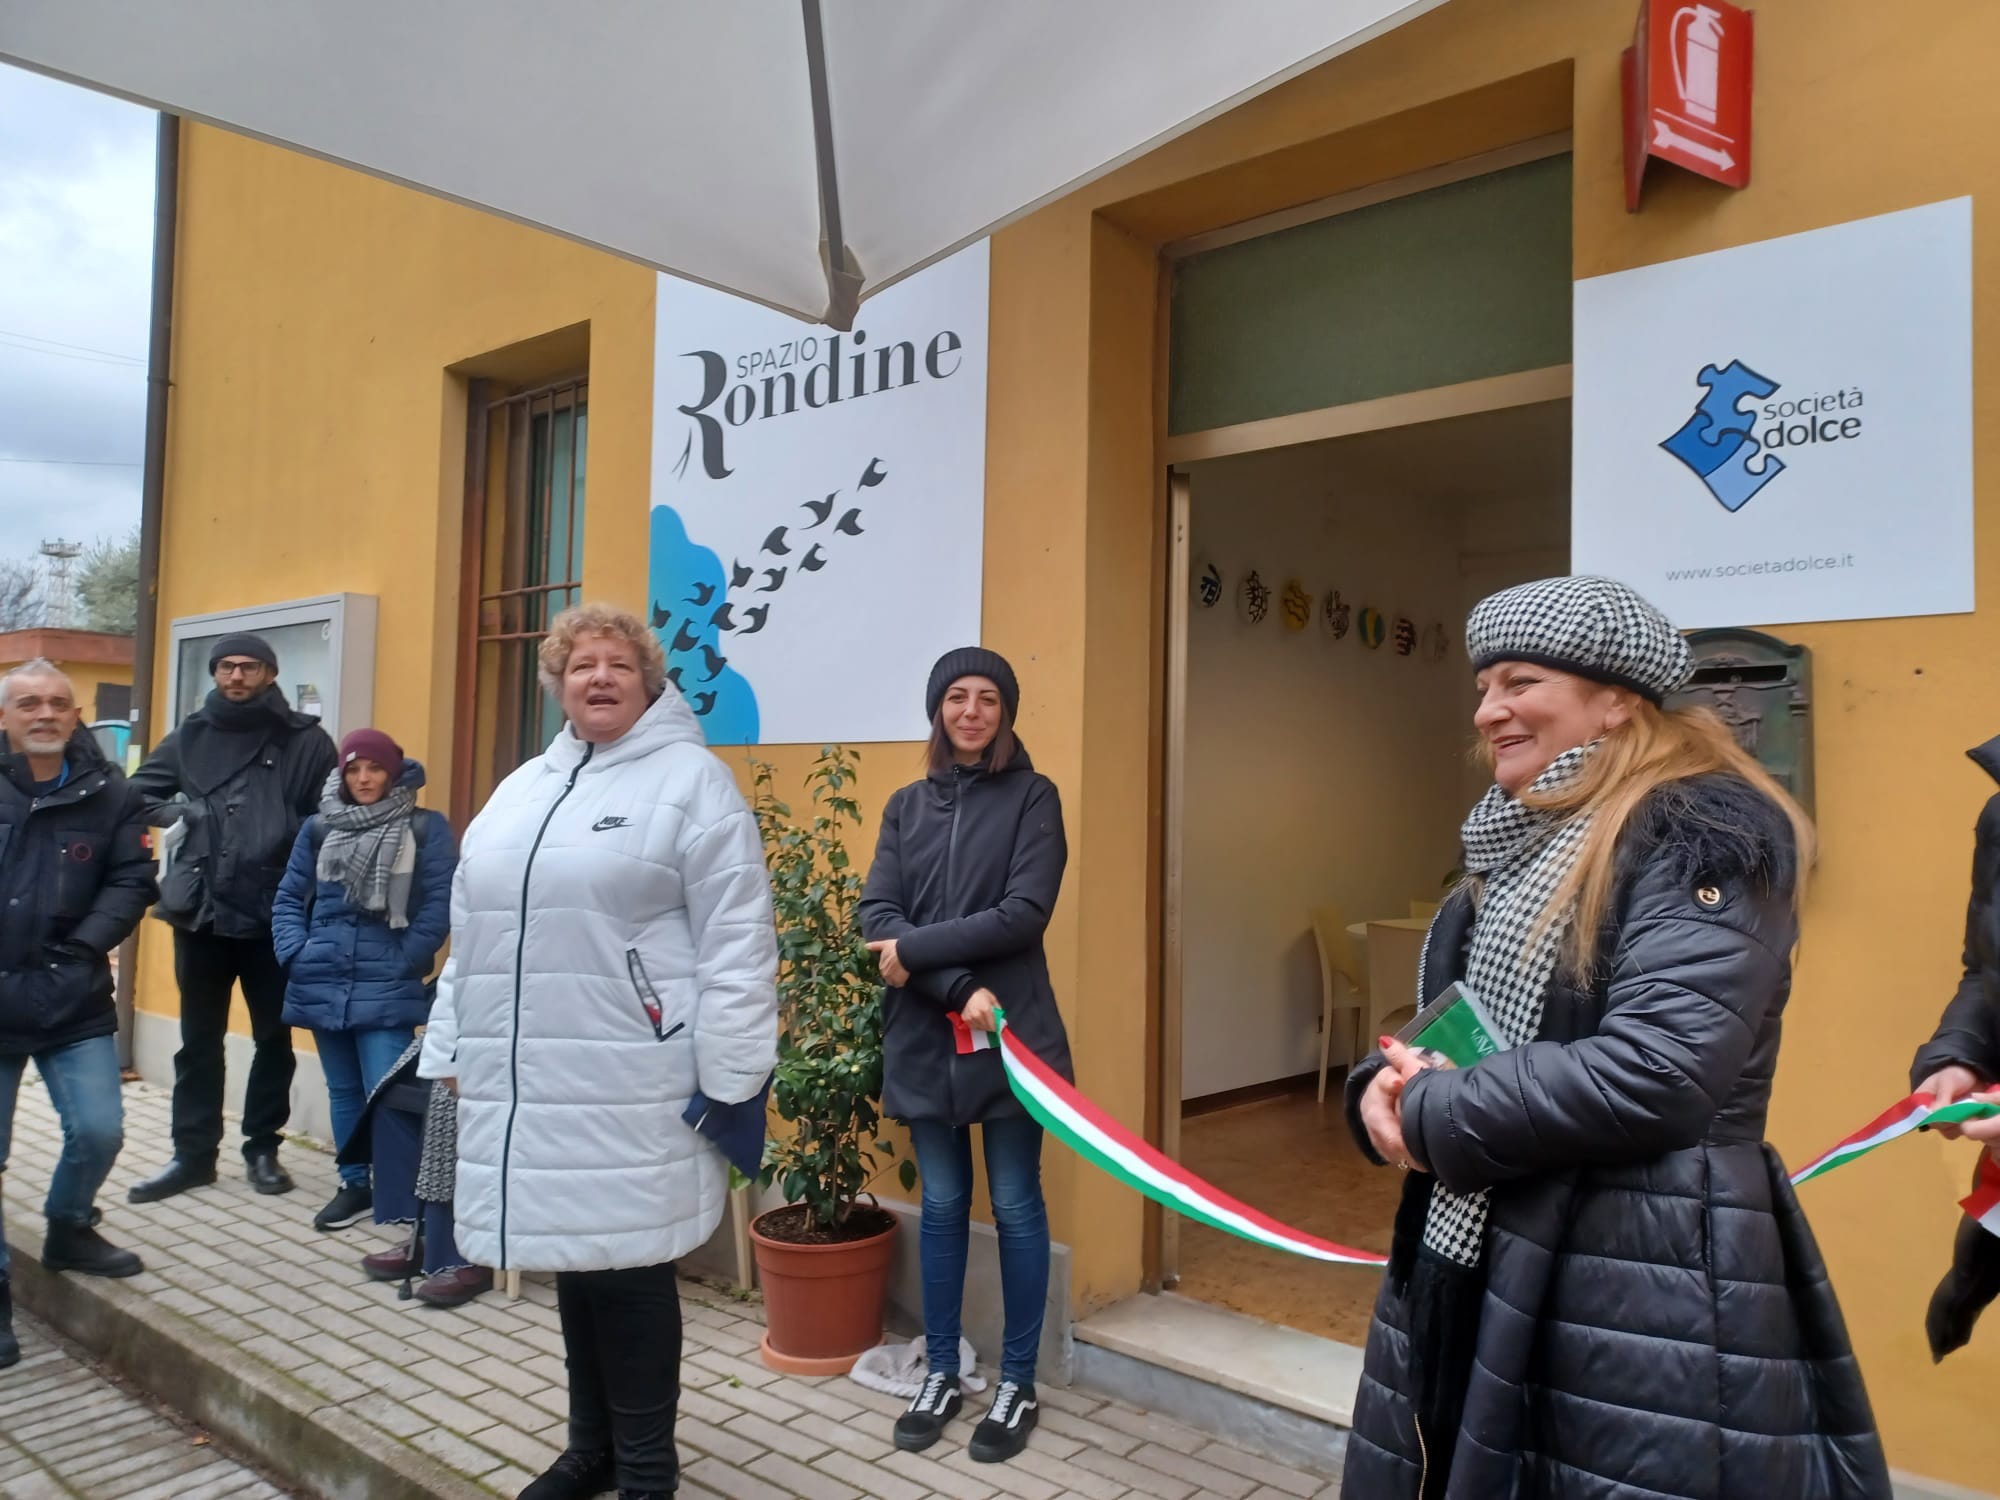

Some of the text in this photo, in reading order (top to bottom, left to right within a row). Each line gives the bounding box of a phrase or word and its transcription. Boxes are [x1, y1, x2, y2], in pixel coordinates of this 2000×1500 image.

[735, 336, 818, 380] SPAZIO
[675, 329, 962, 480] Rondine
[1763, 386, 1864, 421] società
[1763, 415, 1862, 449] dolce
[1665, 553, 1855, 581] www.societadolce.it
